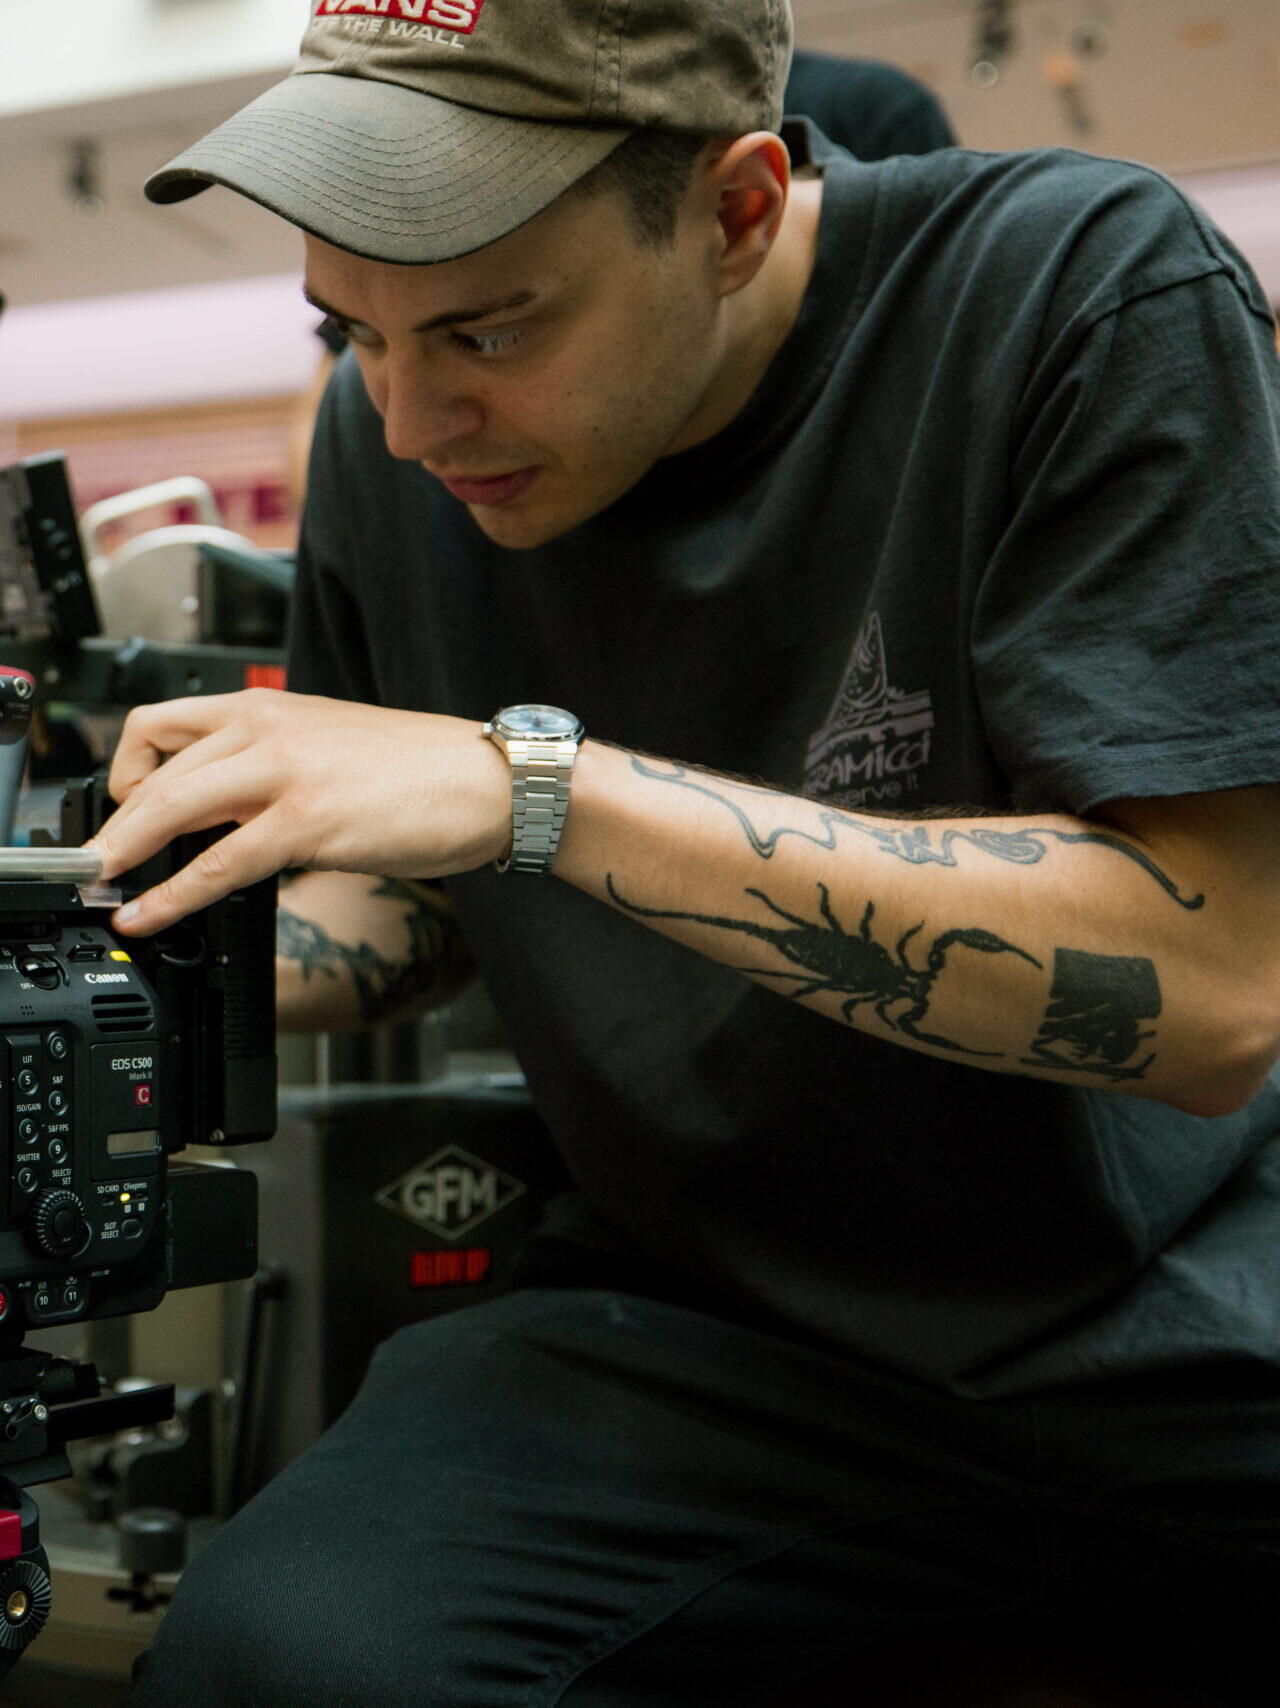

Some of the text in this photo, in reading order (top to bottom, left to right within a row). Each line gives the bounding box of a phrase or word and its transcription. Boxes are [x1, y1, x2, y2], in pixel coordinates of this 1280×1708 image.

[342, 15, 385, 34] THE
[388, 20, 465, 49] WALL
[84, 973, 130, 984] Canon
[22, 1055, 33, 1063] LUT
[111, 1057, 152, 1070] EOS C500
[25, 1076, 31, 1085] 5
[52, 1076, 64, 1084] S&F
[129, 1072, 147, 1080] Mark
[138, 1087, 149, 1103] C
[55, 1096, 61, 1106] 8
[16, 1104, 41, 1112] ISO/GAIN
[26, 1125, 32, 1134] 6
[55, 1144, 61, 1154] 9
[16, 1153, 40, 1162] SHUTTER
[52, 1169, 72, 1177] SELECT/
[25, 1173, 31, 1183] 7
[62, 1178, 72, 1186] SET
[97, 1184, 120, 1194] SD CARD
[123, 1182, 148, 1191] CFexpress
[403, 1166, 497, 1222] GFM
[104, 1222, 117, 1230] SLOT
[101, 1230, 119, 1239] SELECT
[68, 1291, 77, 1301] 11
[40, 1296, 48, 1306] 10
